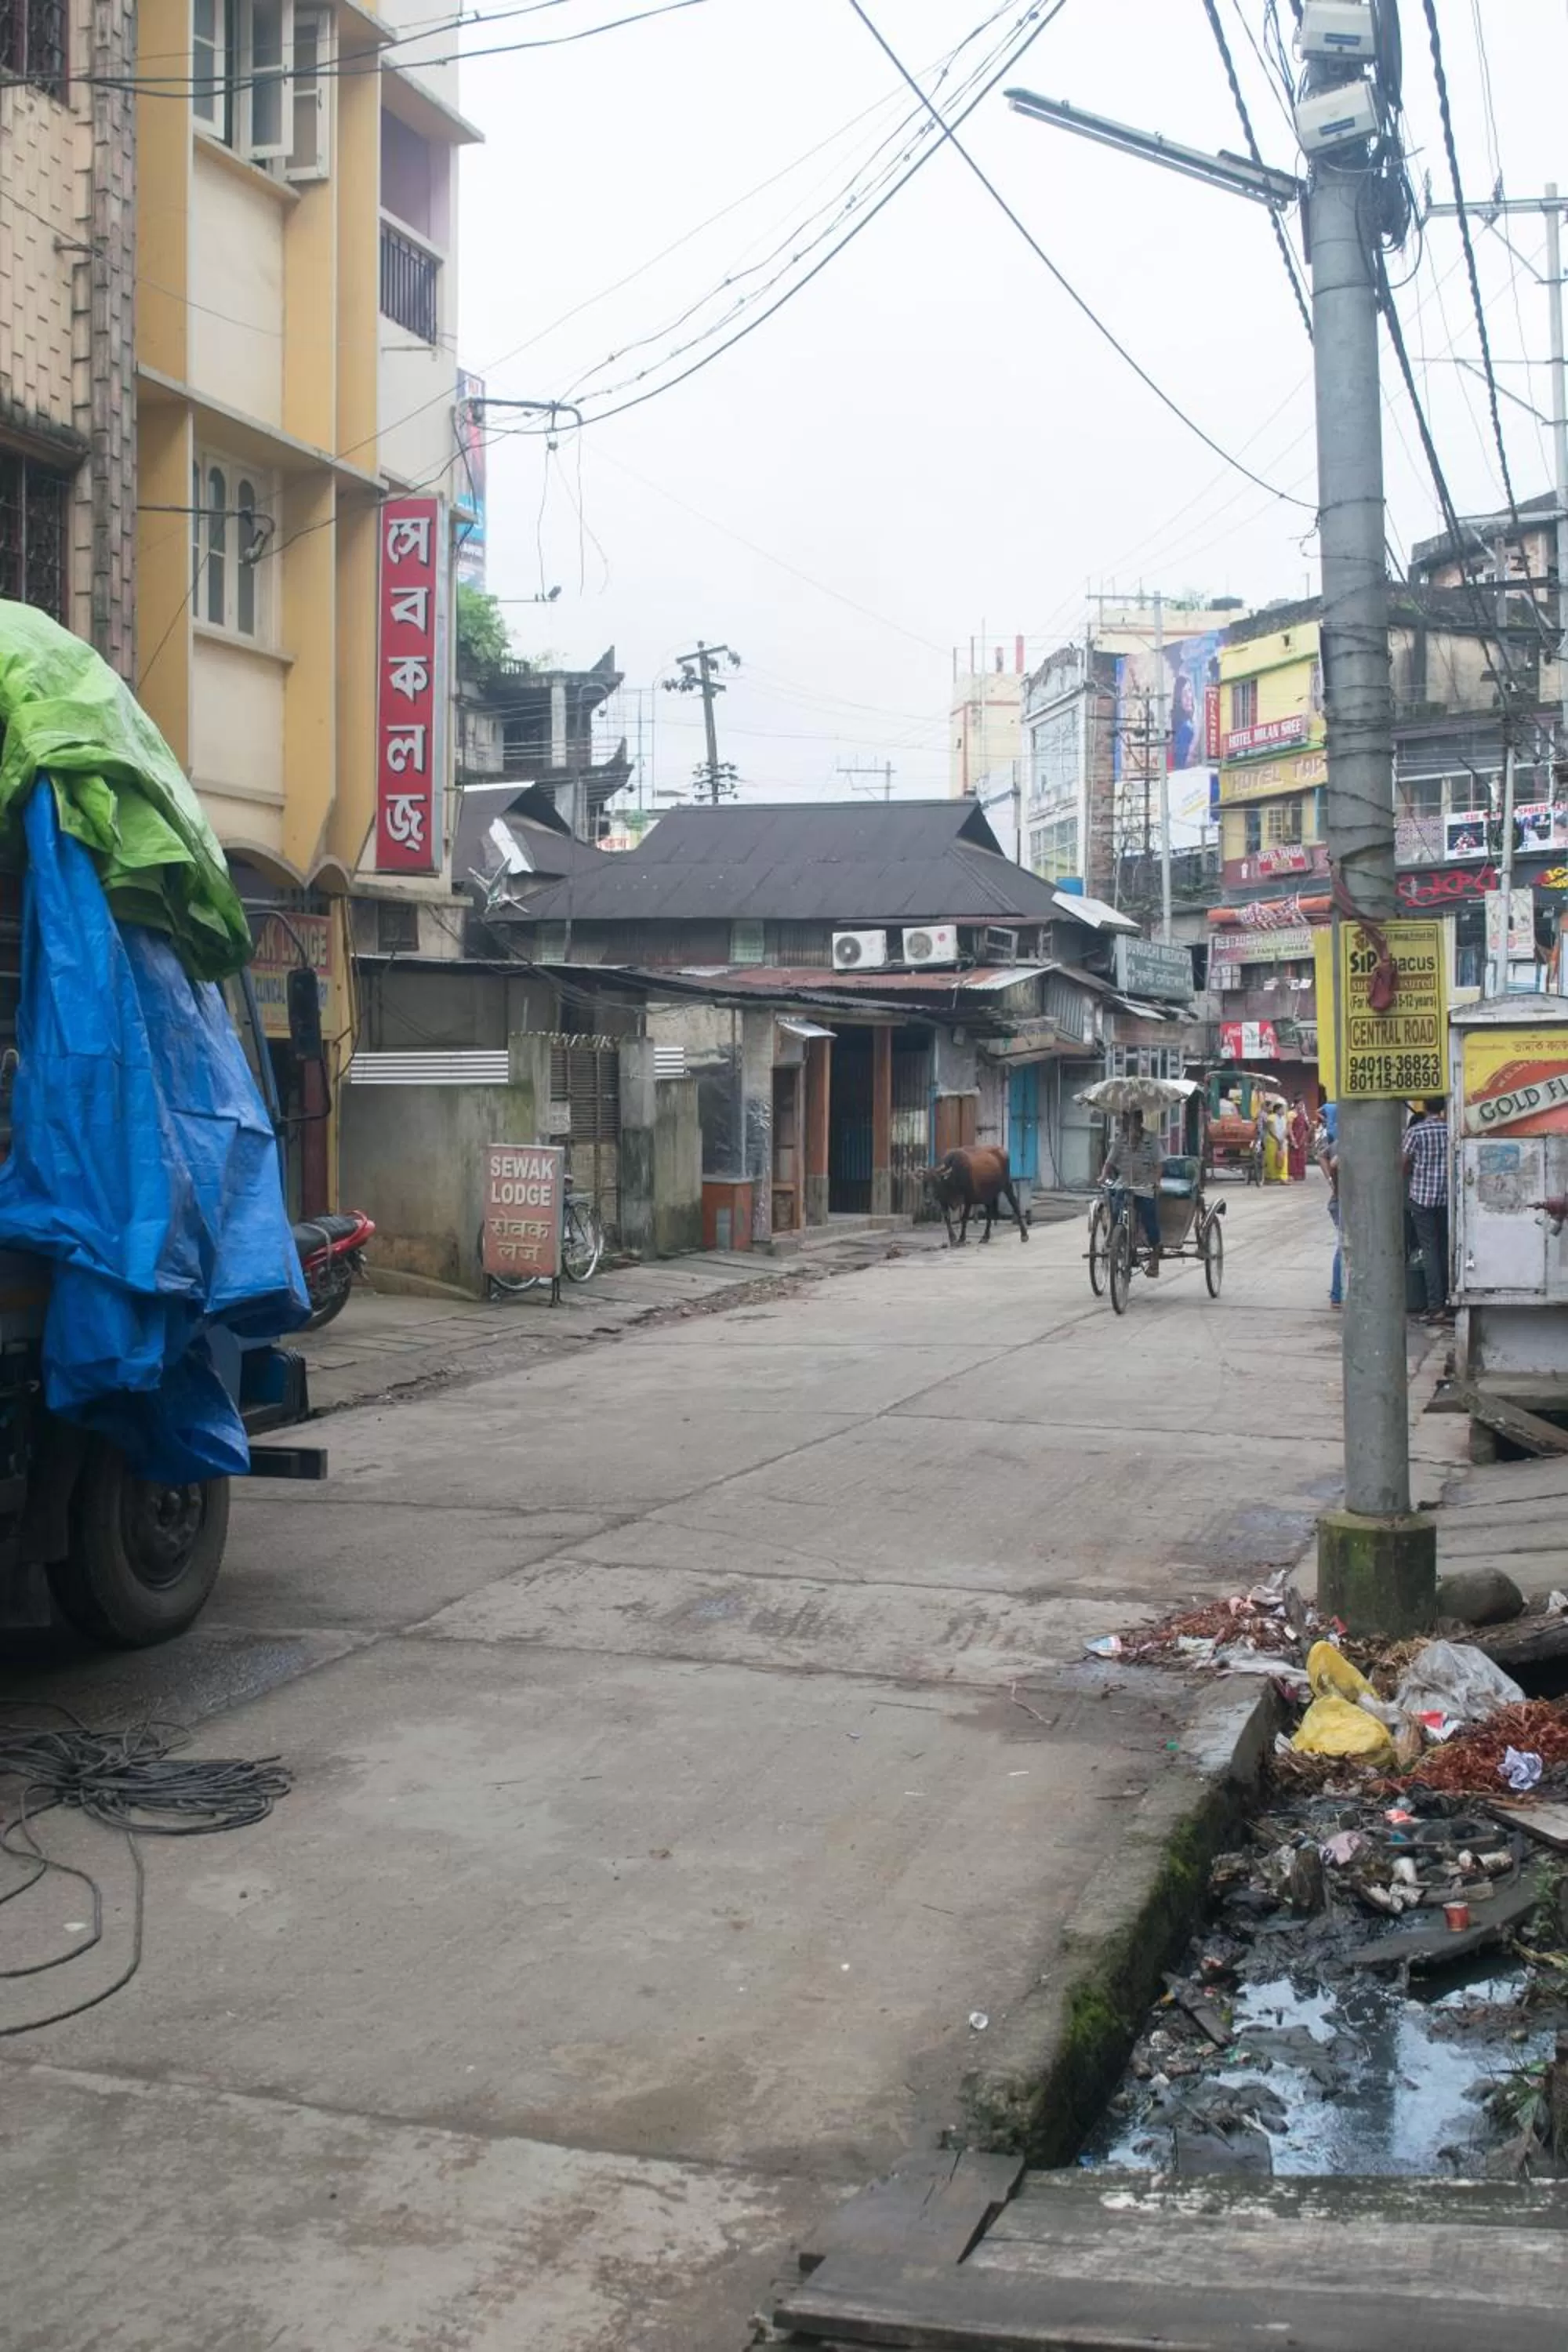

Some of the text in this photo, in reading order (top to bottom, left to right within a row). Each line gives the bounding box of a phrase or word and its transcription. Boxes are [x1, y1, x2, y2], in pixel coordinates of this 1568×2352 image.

[1229, 730, 1252, 749] HOTEL
[1388, 953, 1436, 971] bacus
[1352, 1018, 1435, 1047] CENTRAL ROAD
[1349, 1054, 1440, 1073] 94016-36823
[1349, 1072, 1439, 1091] 80115-08690
[1479, 1088, 1541, 1122] GOLD
[490, 1155, 555, 1180] SEWAK
[490, 1181, 552, 1207] LODGE
